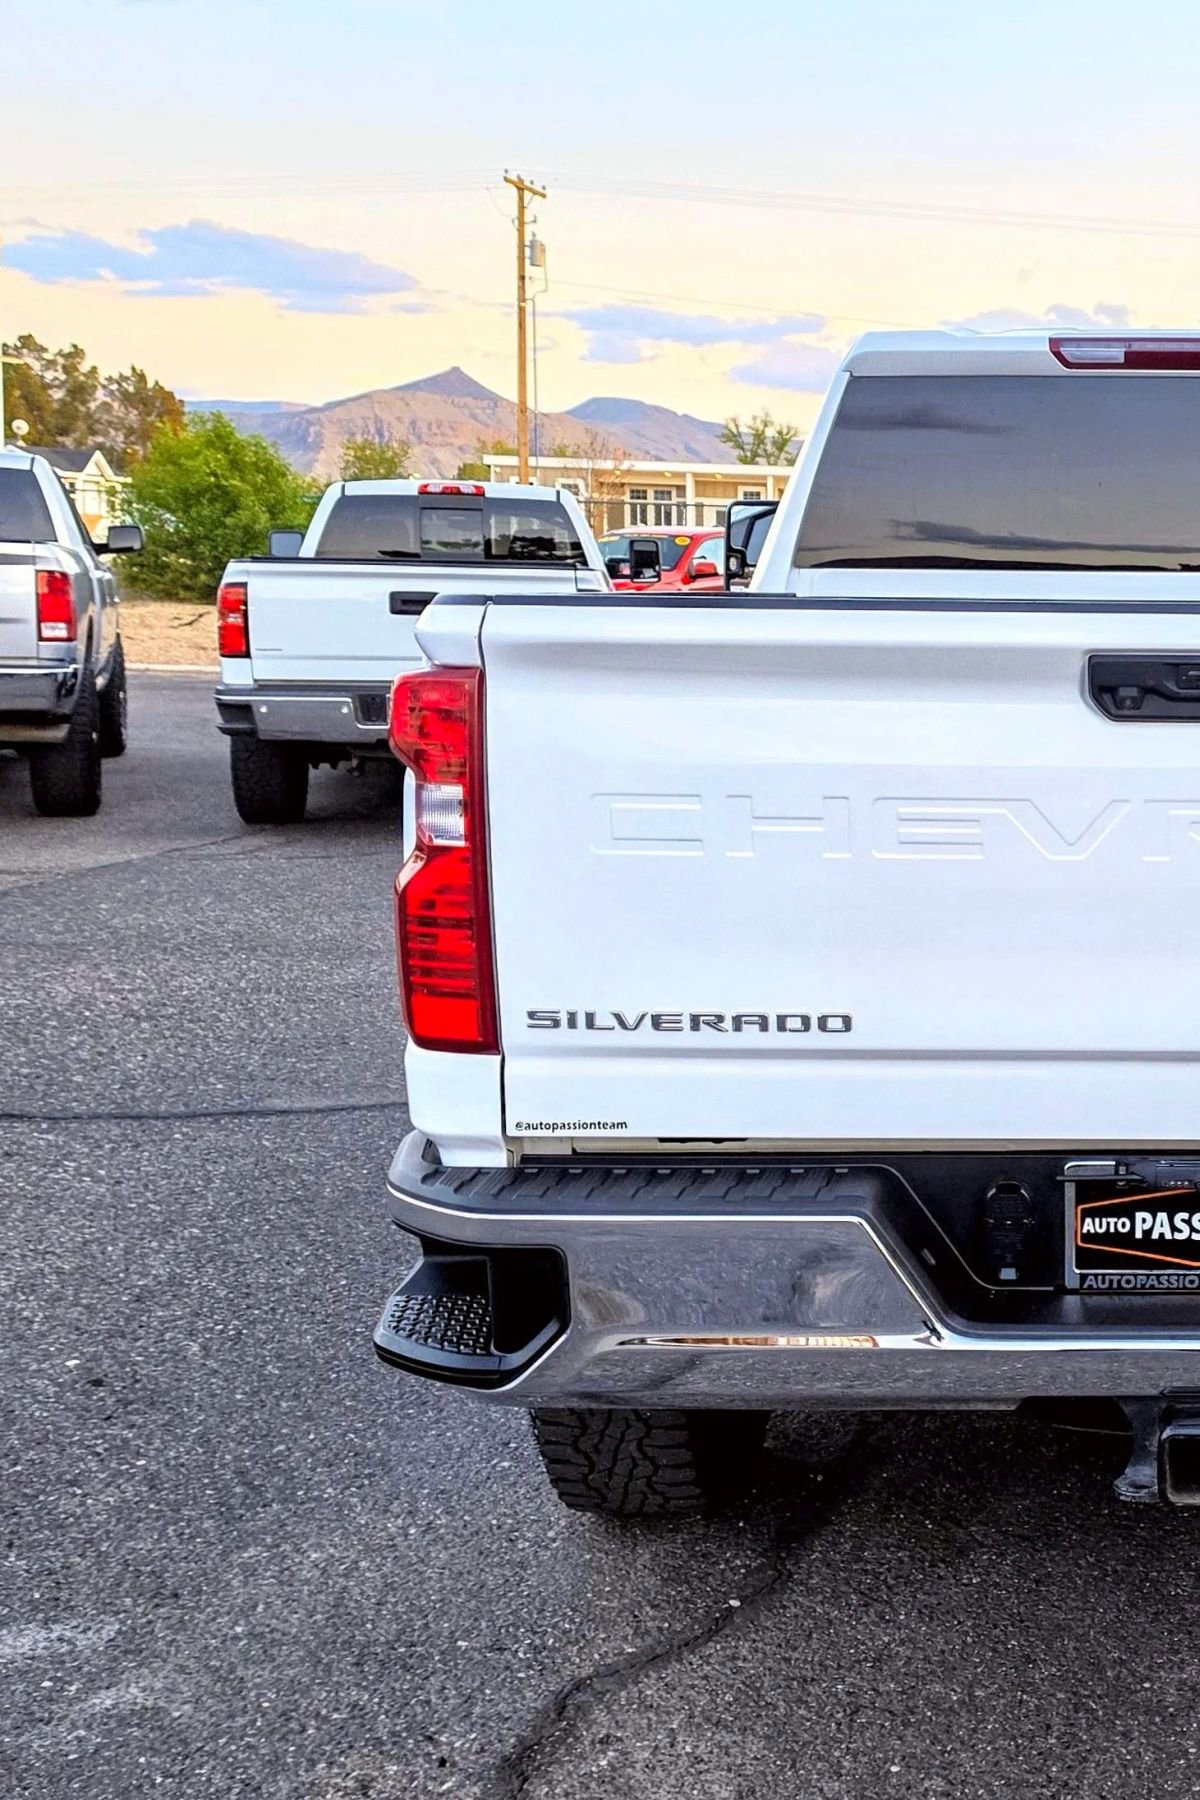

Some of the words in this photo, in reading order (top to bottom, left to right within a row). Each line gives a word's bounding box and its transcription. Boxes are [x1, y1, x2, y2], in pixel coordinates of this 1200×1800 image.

[526, 1008, 854, 1033] SILVERADO
[515, 1120, 628, 1133] @autopassionteam
[1082, 1217, 1131, 1234] AUTO
